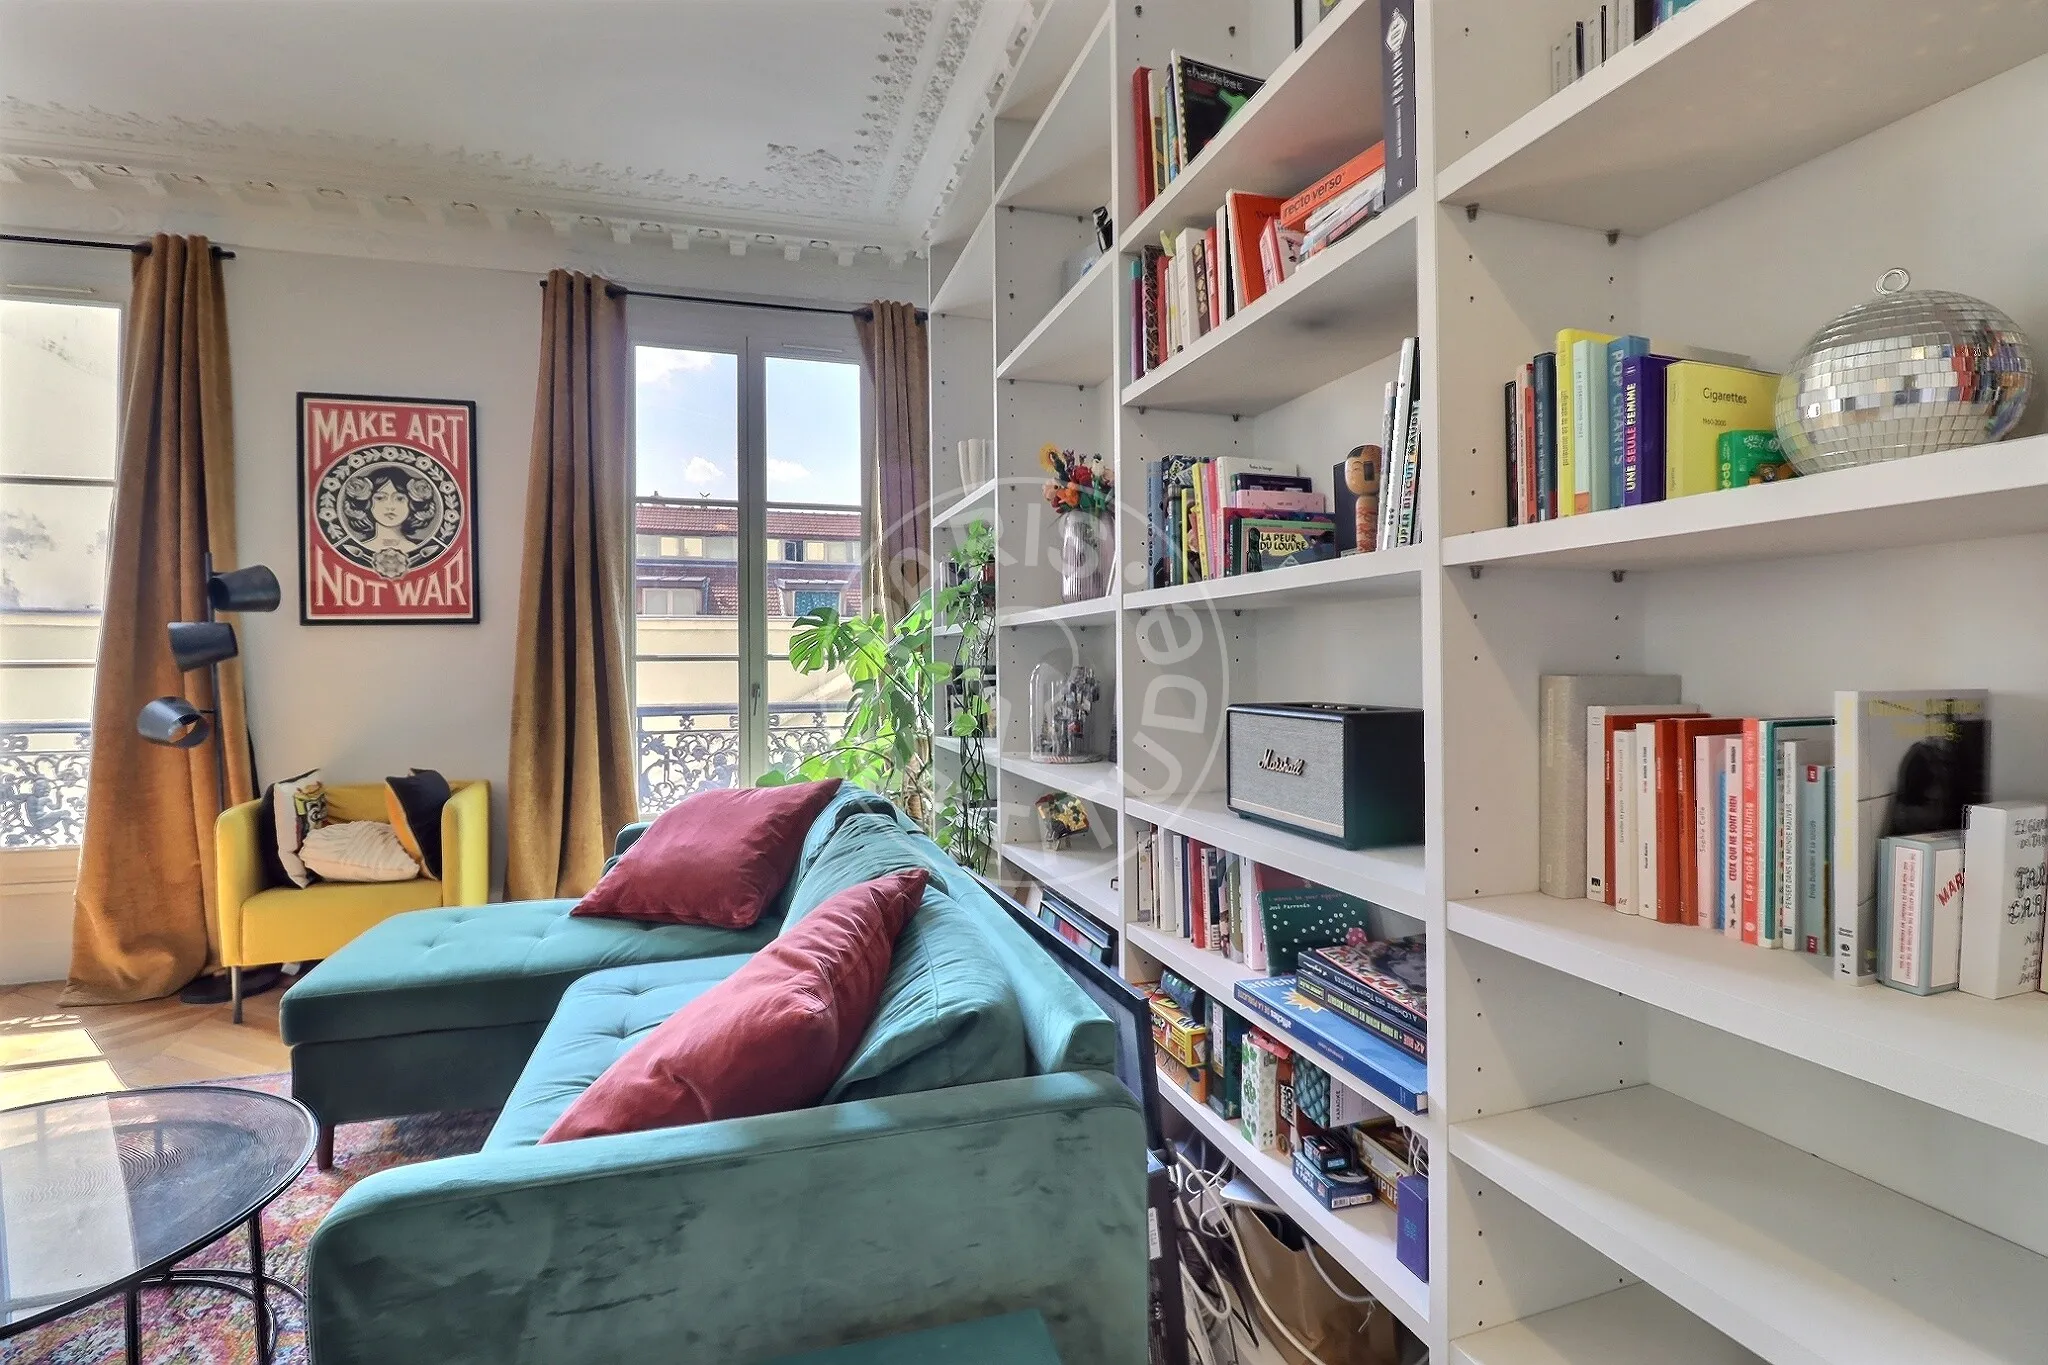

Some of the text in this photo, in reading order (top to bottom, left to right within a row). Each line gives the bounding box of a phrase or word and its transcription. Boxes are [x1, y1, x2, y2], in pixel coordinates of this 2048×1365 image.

[1283, 173, 1343, 218] recto verso
[1610, 349, 1625, 466] POP CHARTS
[1702, 387, 1748, 405] Cigarettes
[311, 407, 464, 470] MAKE ART
[1625, 382, 1637, 492] UNE SEULE FEMME
[1260, 533, 1297, 543] LA PEUR
[1260, 541, 1307, 552] DU LOUVRE
[314, 544, 468, 607] NOT WAR
[1257, 748, 1305, 776] Marshall
[1785, 803, 1793, 831] MAUVAIS
[1728, 795, 1738, 881] CEUX QUI NE SONT RIEN
[1743, 840, 1754, 854] du
[1744, 856, 1754, 882] mots
[1784, 867, 1792, 883] DANS
[1743, 885, 1754, 902] Les
[1784, 885, 1792, 910] PENSER
[1936, 871, 1966, 906] MAR
